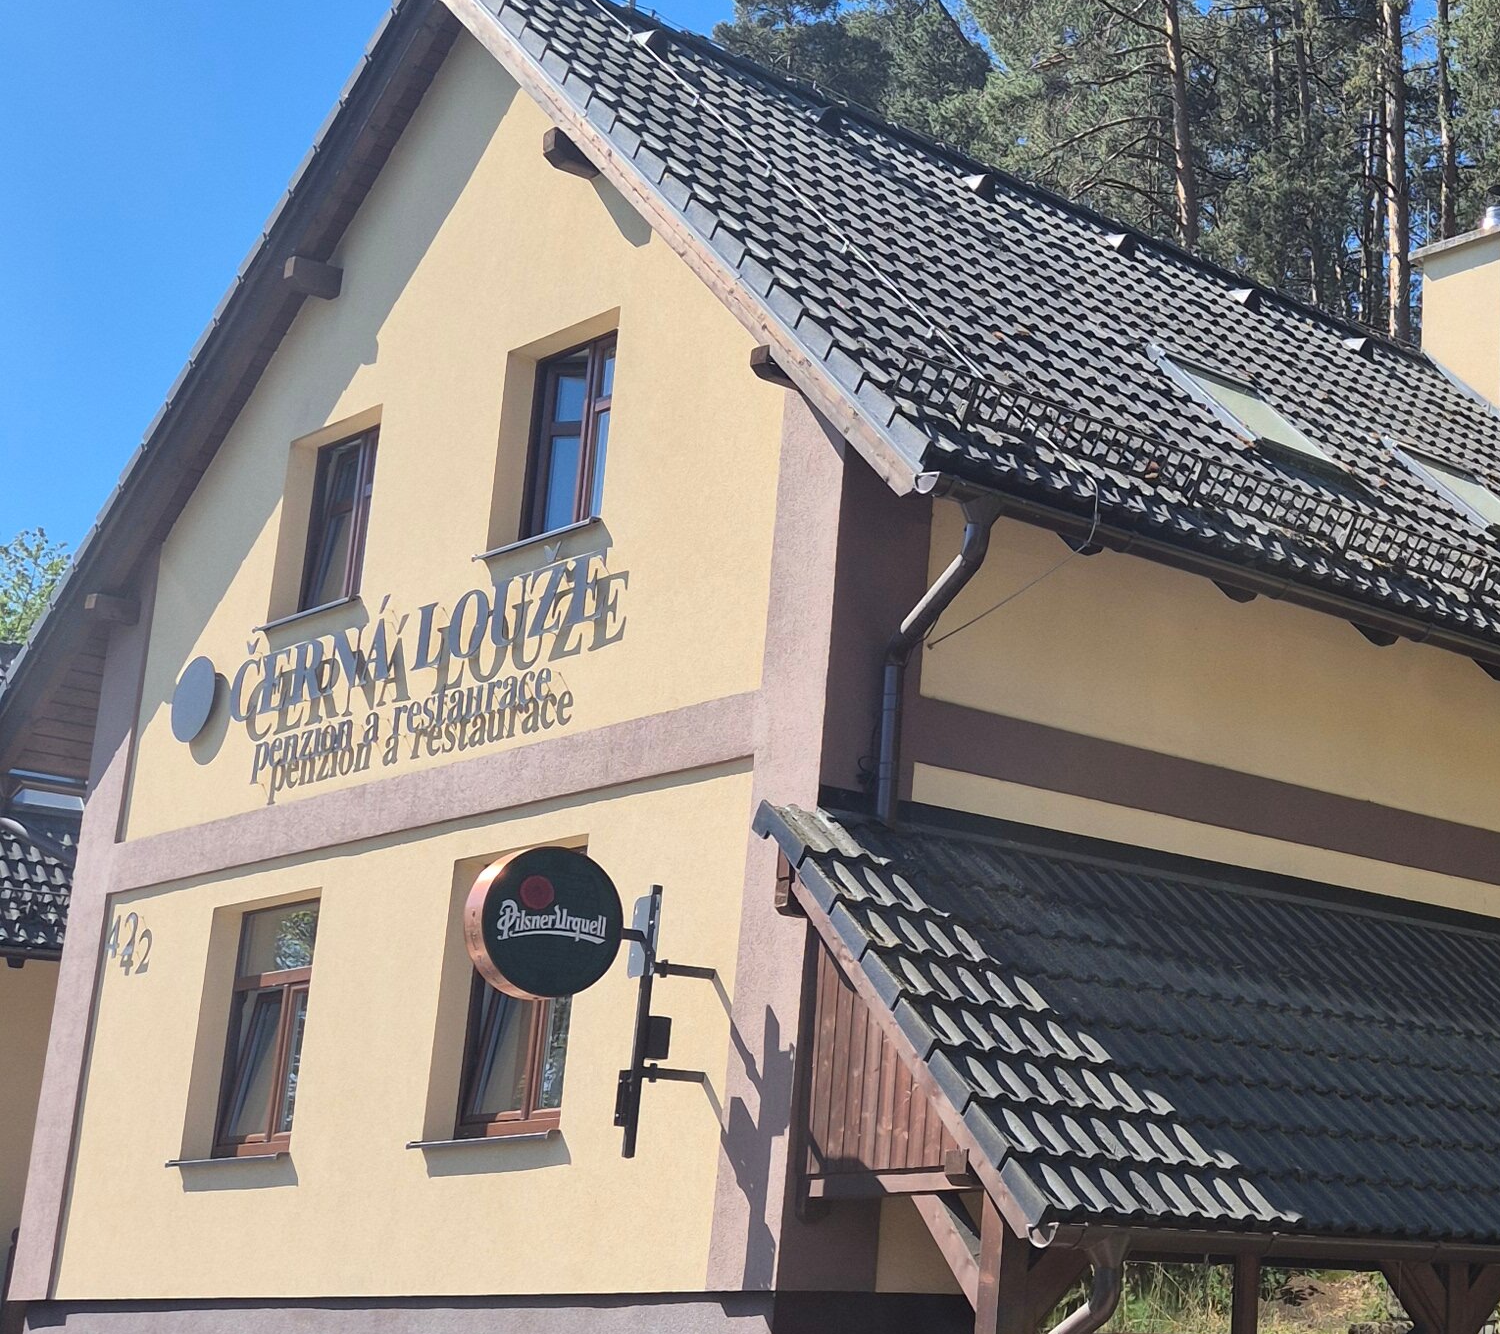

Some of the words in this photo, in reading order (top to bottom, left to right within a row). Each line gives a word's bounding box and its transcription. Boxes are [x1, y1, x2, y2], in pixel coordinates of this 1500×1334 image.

[229, 593, 390, 723] ČERNÁ
[411, 541, 608, 672] LOUŽE
[249, 719, 353, 785] penzion
[363, 712, 379, 745] a
[393, 668, 551, 736] restaurace
[104, 912, 139, 959] 42
[497, 899, 556, 940] Pilsner
[554, 904, 607, 942] Urquell
